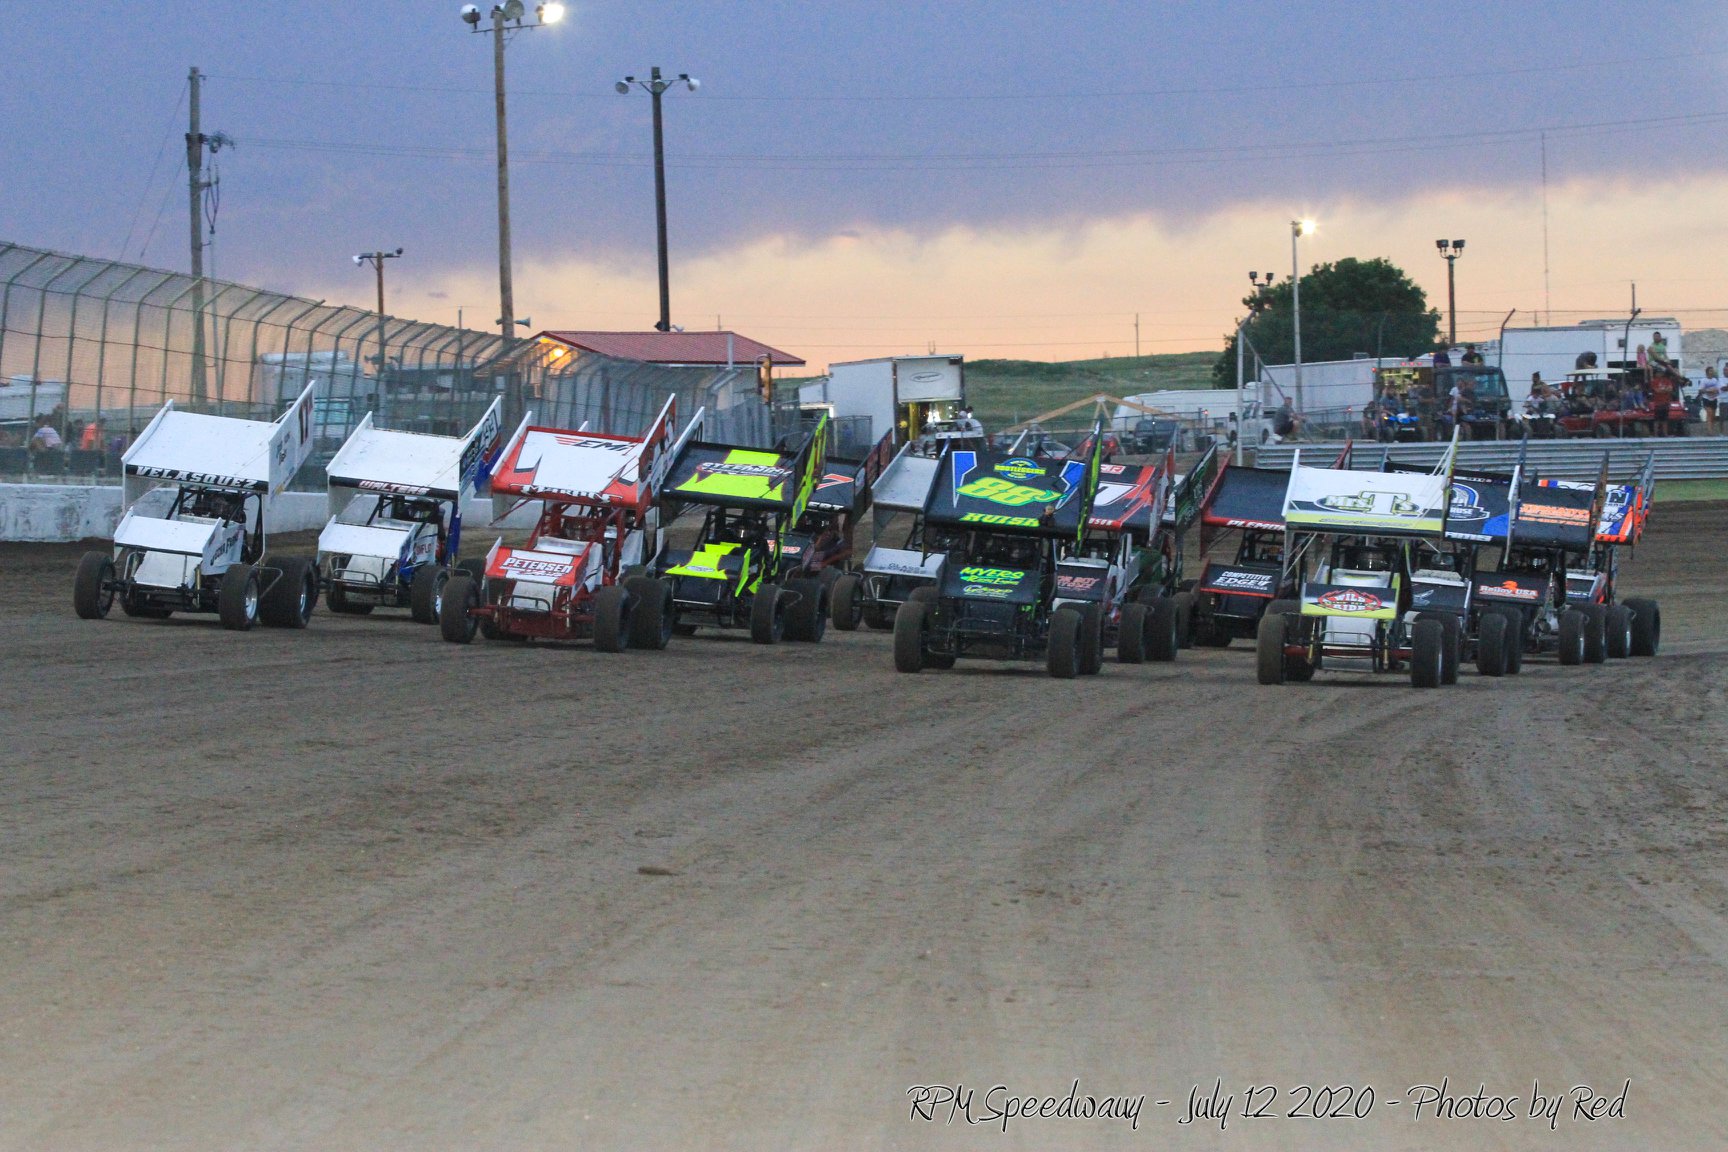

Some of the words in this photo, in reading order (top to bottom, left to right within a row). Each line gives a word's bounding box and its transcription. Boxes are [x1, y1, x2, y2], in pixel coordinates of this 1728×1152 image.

[135, 465, 258, 489] VELASQUEZ
[358, 480, 430, 496] WALTERS
[501, 557, 574, 574] PETERSEN
[960, 566, 1025, 579] MYERS
[1221, 571, 1272, 581] COMPETITIVE
[1335, 593, 1366, 603] WILD
[1333, 604, 1366, 612] RIDE
